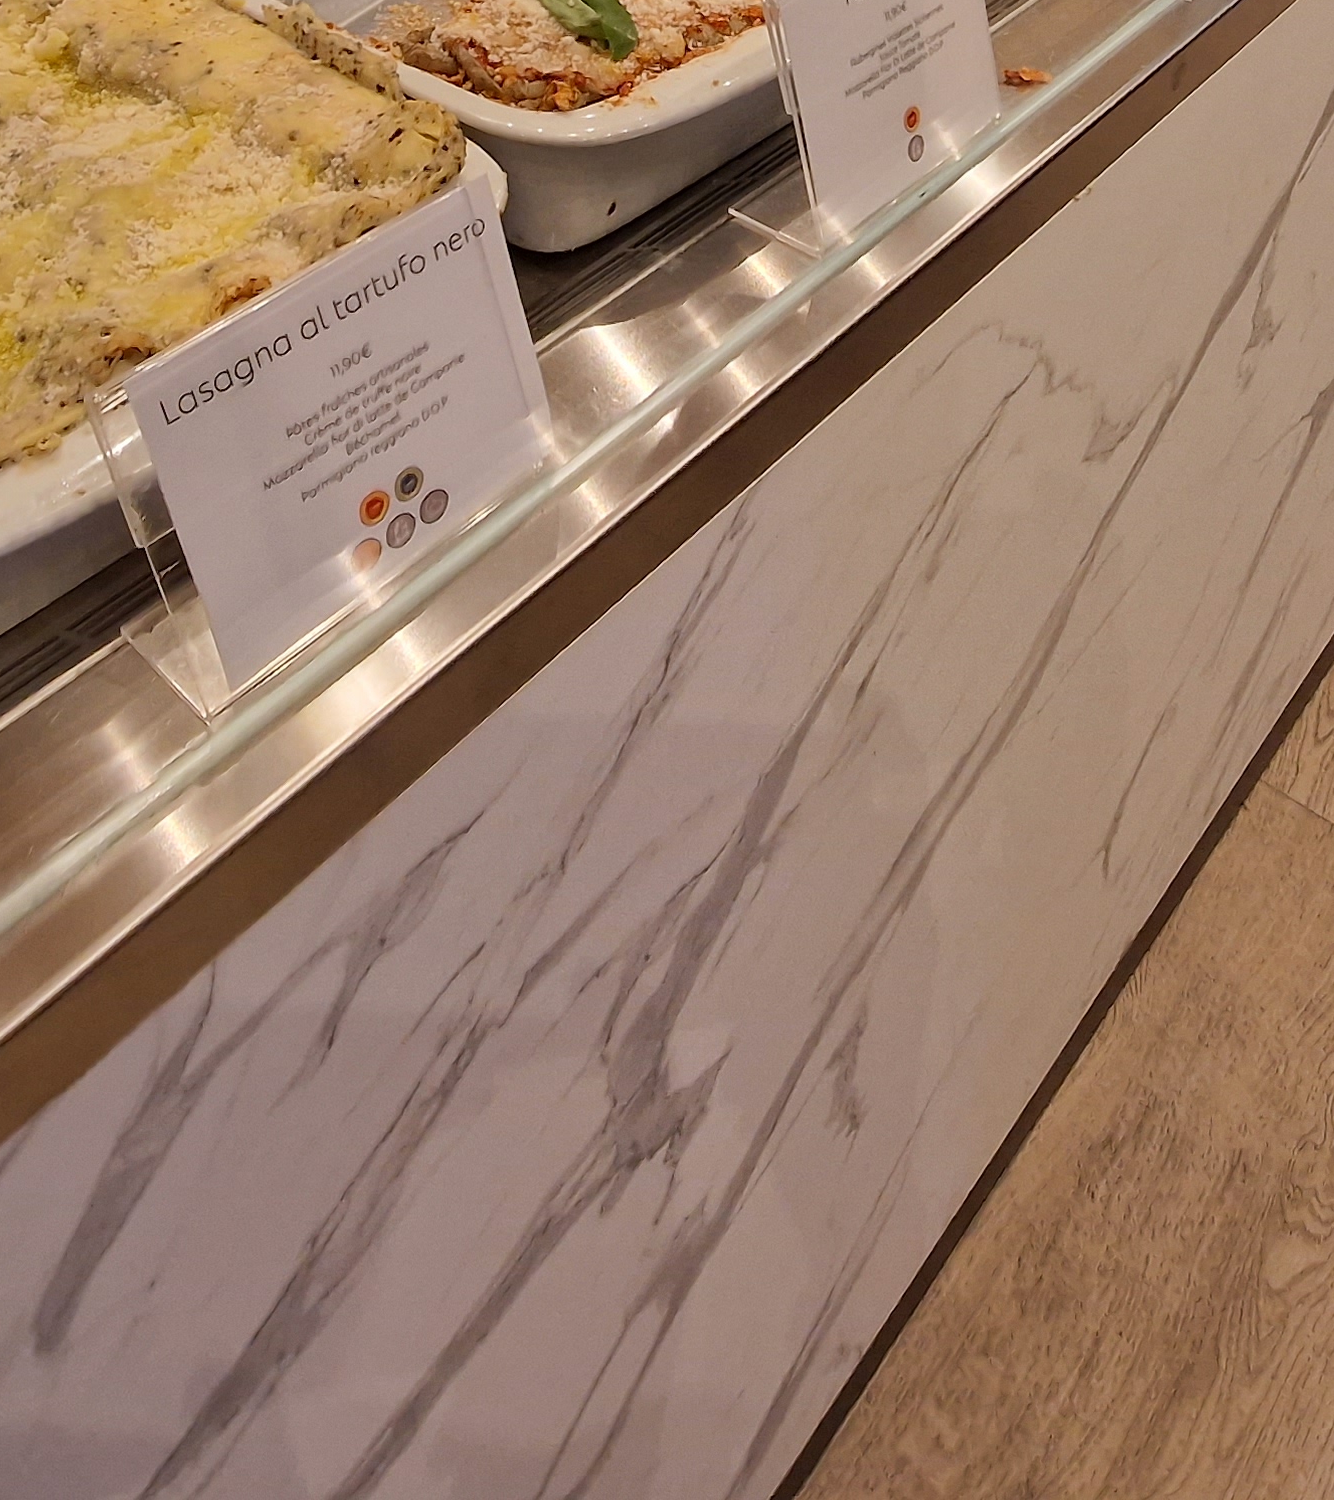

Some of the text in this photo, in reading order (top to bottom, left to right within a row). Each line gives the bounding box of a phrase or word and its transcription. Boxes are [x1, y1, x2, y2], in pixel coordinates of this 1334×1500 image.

[158, 217, 487, 426] Lasagna al tartufo nero
[329, 341, 373, 378] 11,90€
